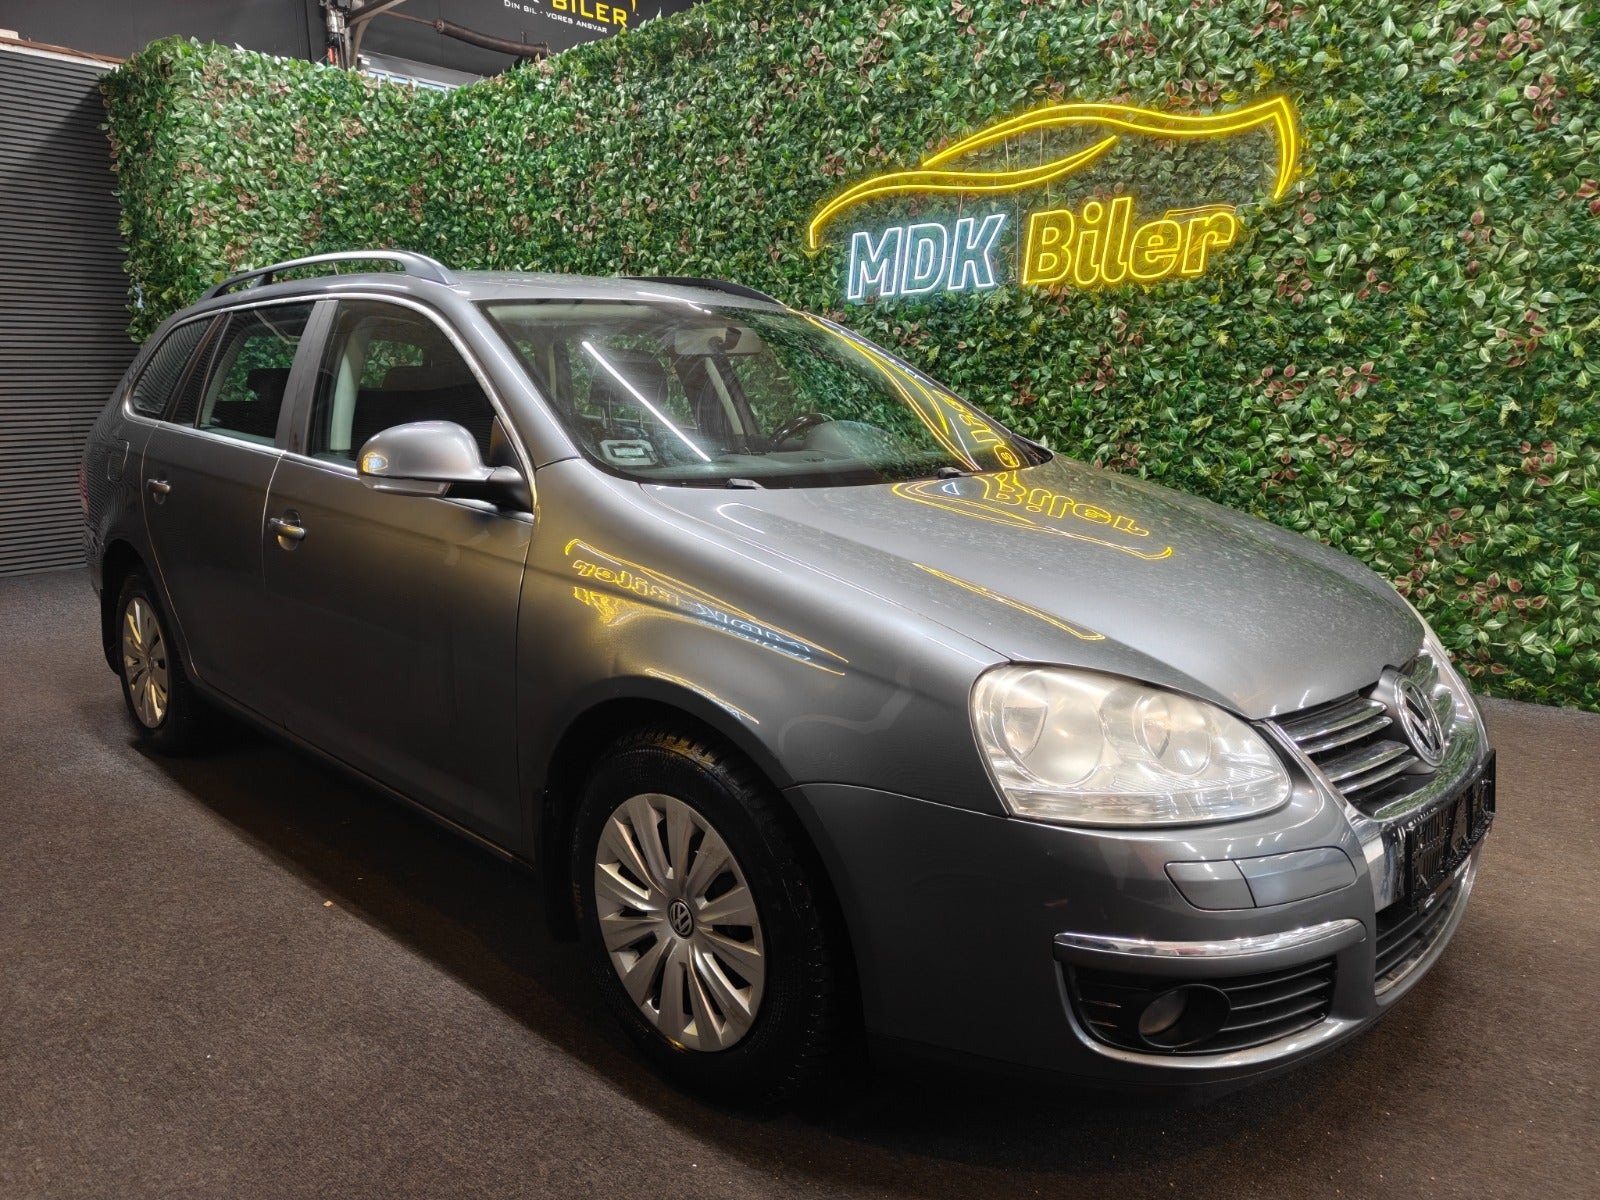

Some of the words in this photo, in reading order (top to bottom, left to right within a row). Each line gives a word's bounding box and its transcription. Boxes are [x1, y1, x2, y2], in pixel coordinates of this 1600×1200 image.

[523, 5, 538, 15] BIL
[545, 11, 574, 25] VORES
[576, 20, 608, 34] ANSVAR
[847, 213, 1006, 301] MDK
[1022, 196, 1238, 286] Biler
